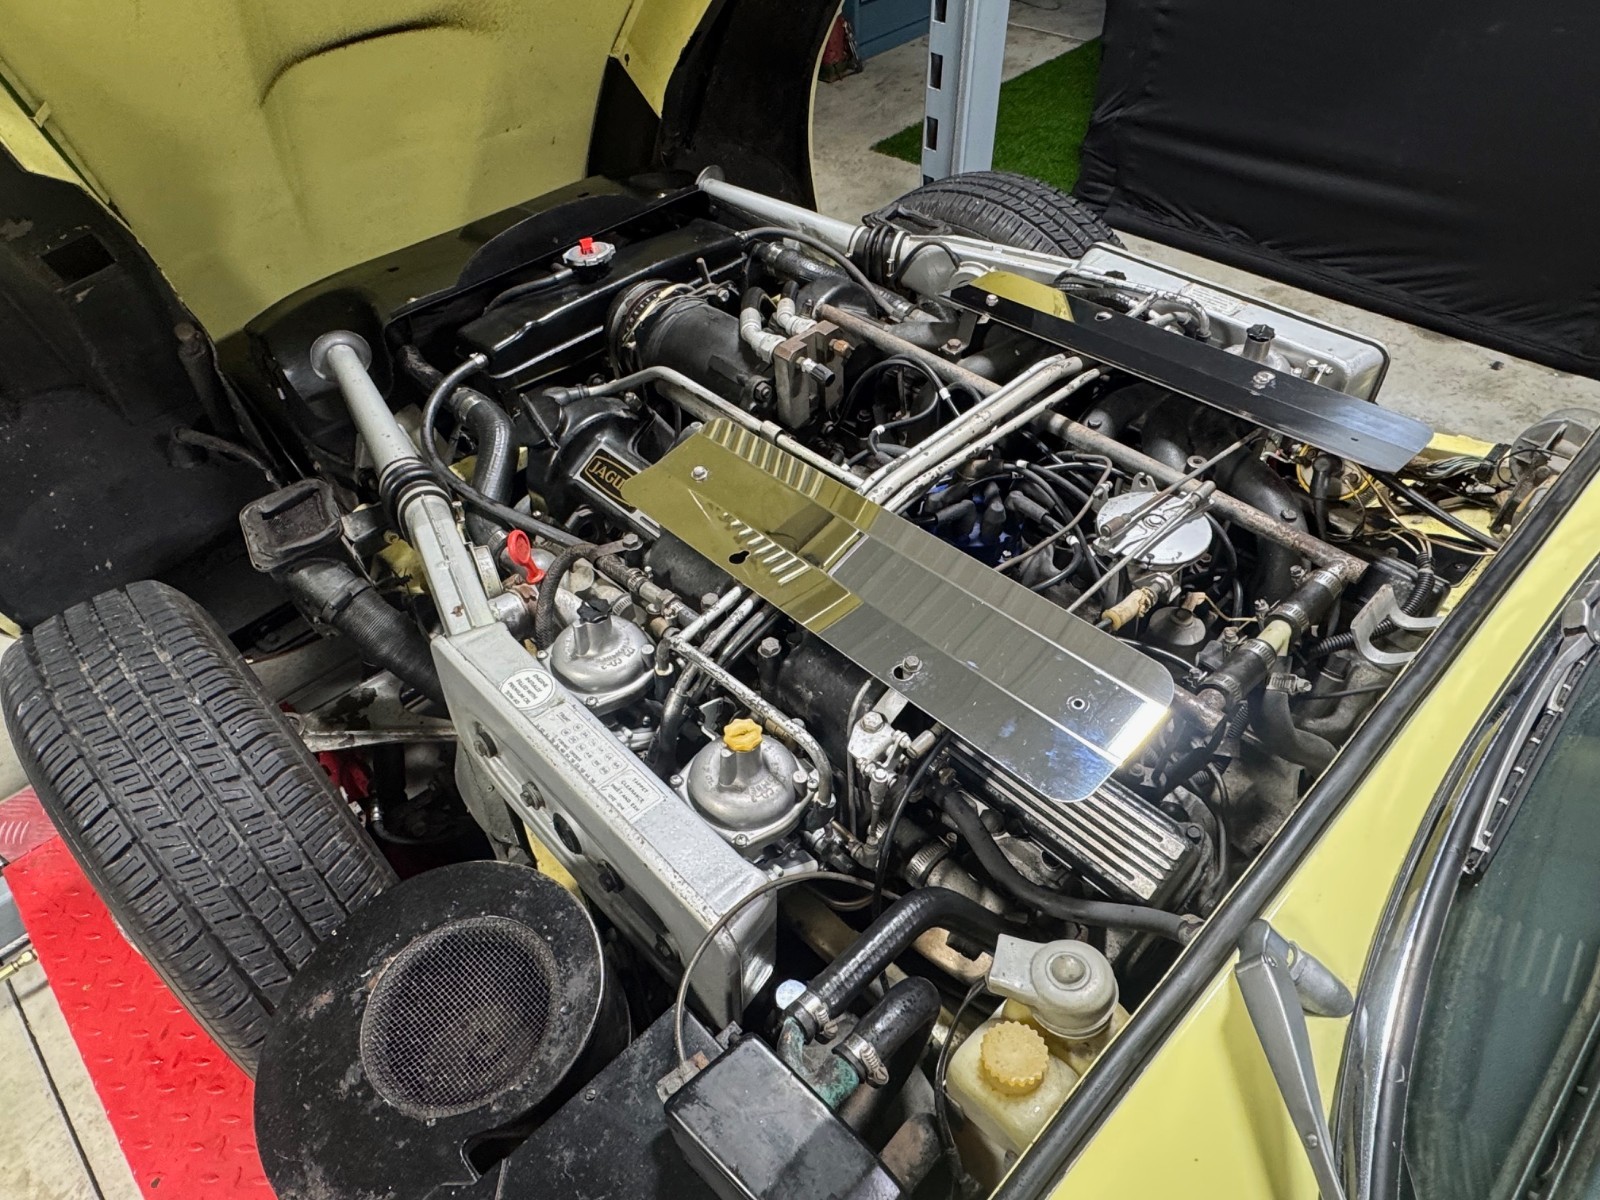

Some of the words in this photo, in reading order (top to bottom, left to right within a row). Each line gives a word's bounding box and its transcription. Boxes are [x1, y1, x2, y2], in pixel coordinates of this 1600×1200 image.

[589, 460, 626, 490] JAGU
[532, 673, 549, 687] ENGINE
[619, 779, 644, 803] CLEARANCE
[631, 777, 649, 794] TAPPET
[620, 793, 631, 803] AND
